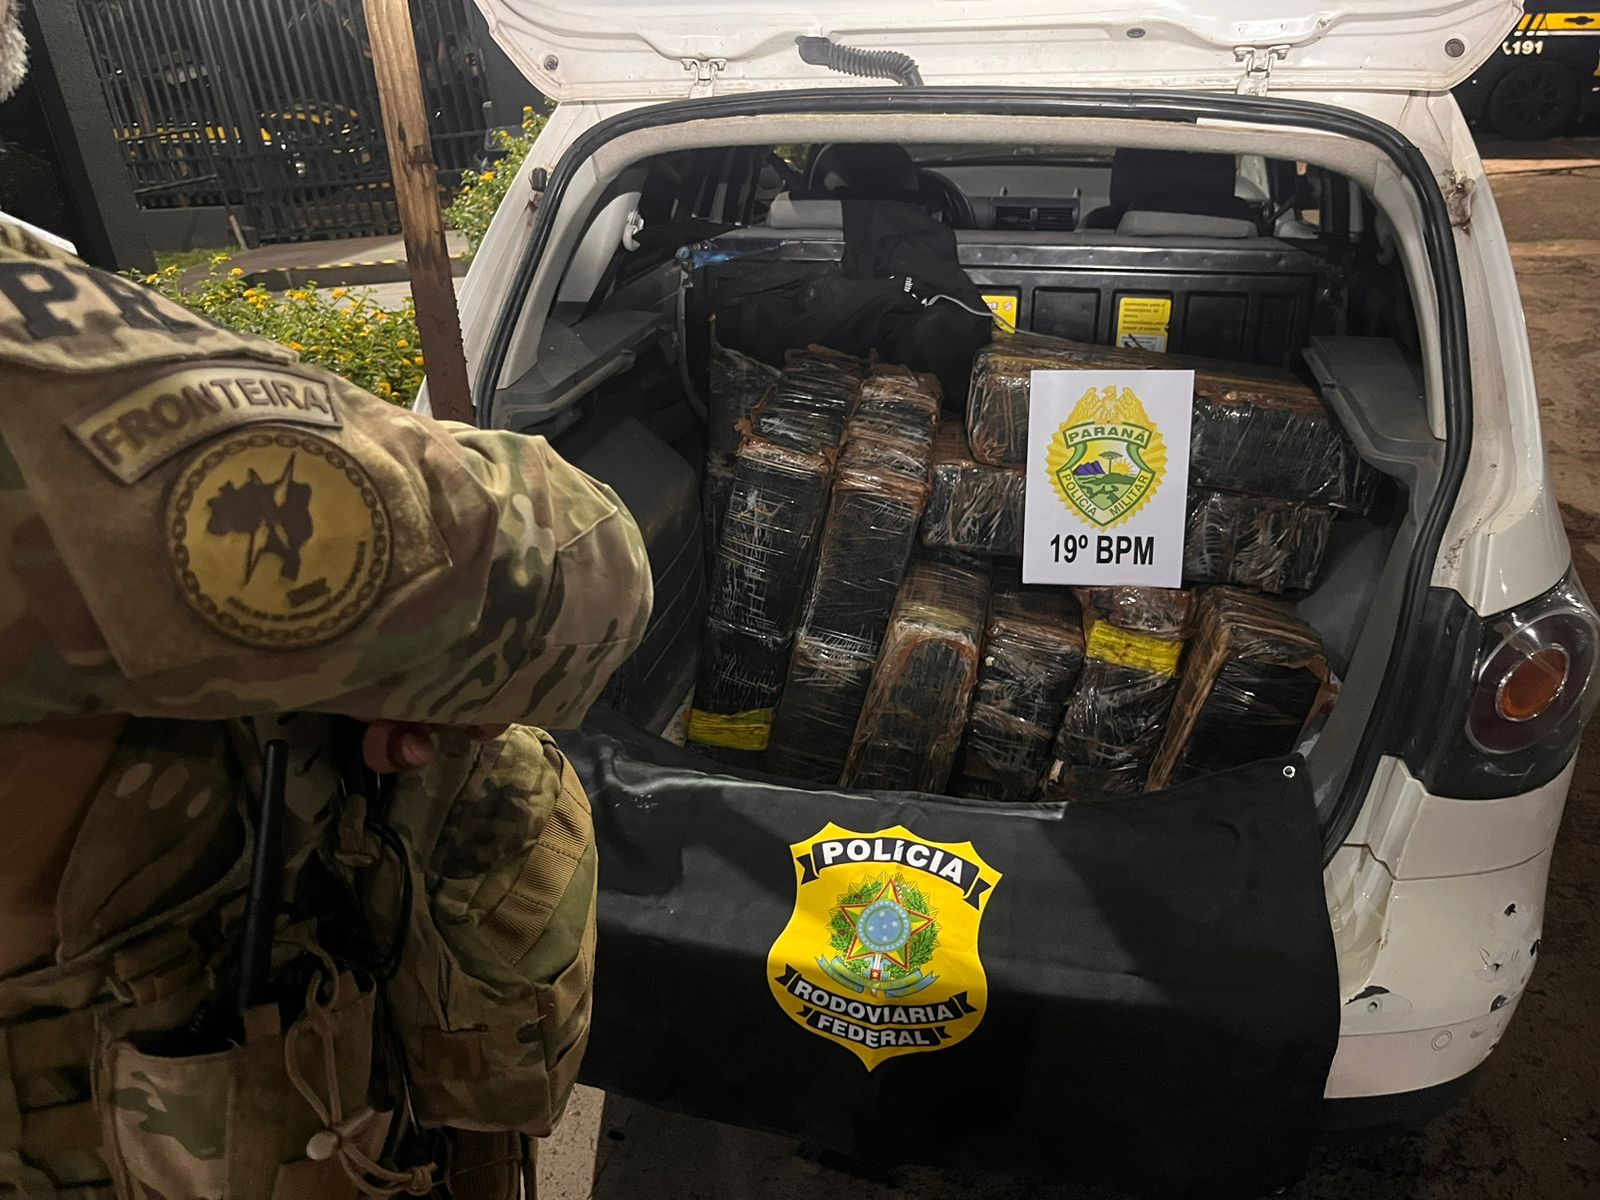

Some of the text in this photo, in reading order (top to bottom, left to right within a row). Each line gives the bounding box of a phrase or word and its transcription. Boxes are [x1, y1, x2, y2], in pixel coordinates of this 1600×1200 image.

[1512, 40, 1543, 55] 191
[90, 377, 330, 466] FRONTEIRA
[1068, 426, 1146, 444] PARANÁ
[1109, 476, 1149, 516] MILITAR
[1096, 535, 1155, 565] BPM
[821, 838, 963, 884] POLÍCIA
[817, 1014, 930, 1048] FEDERAL
